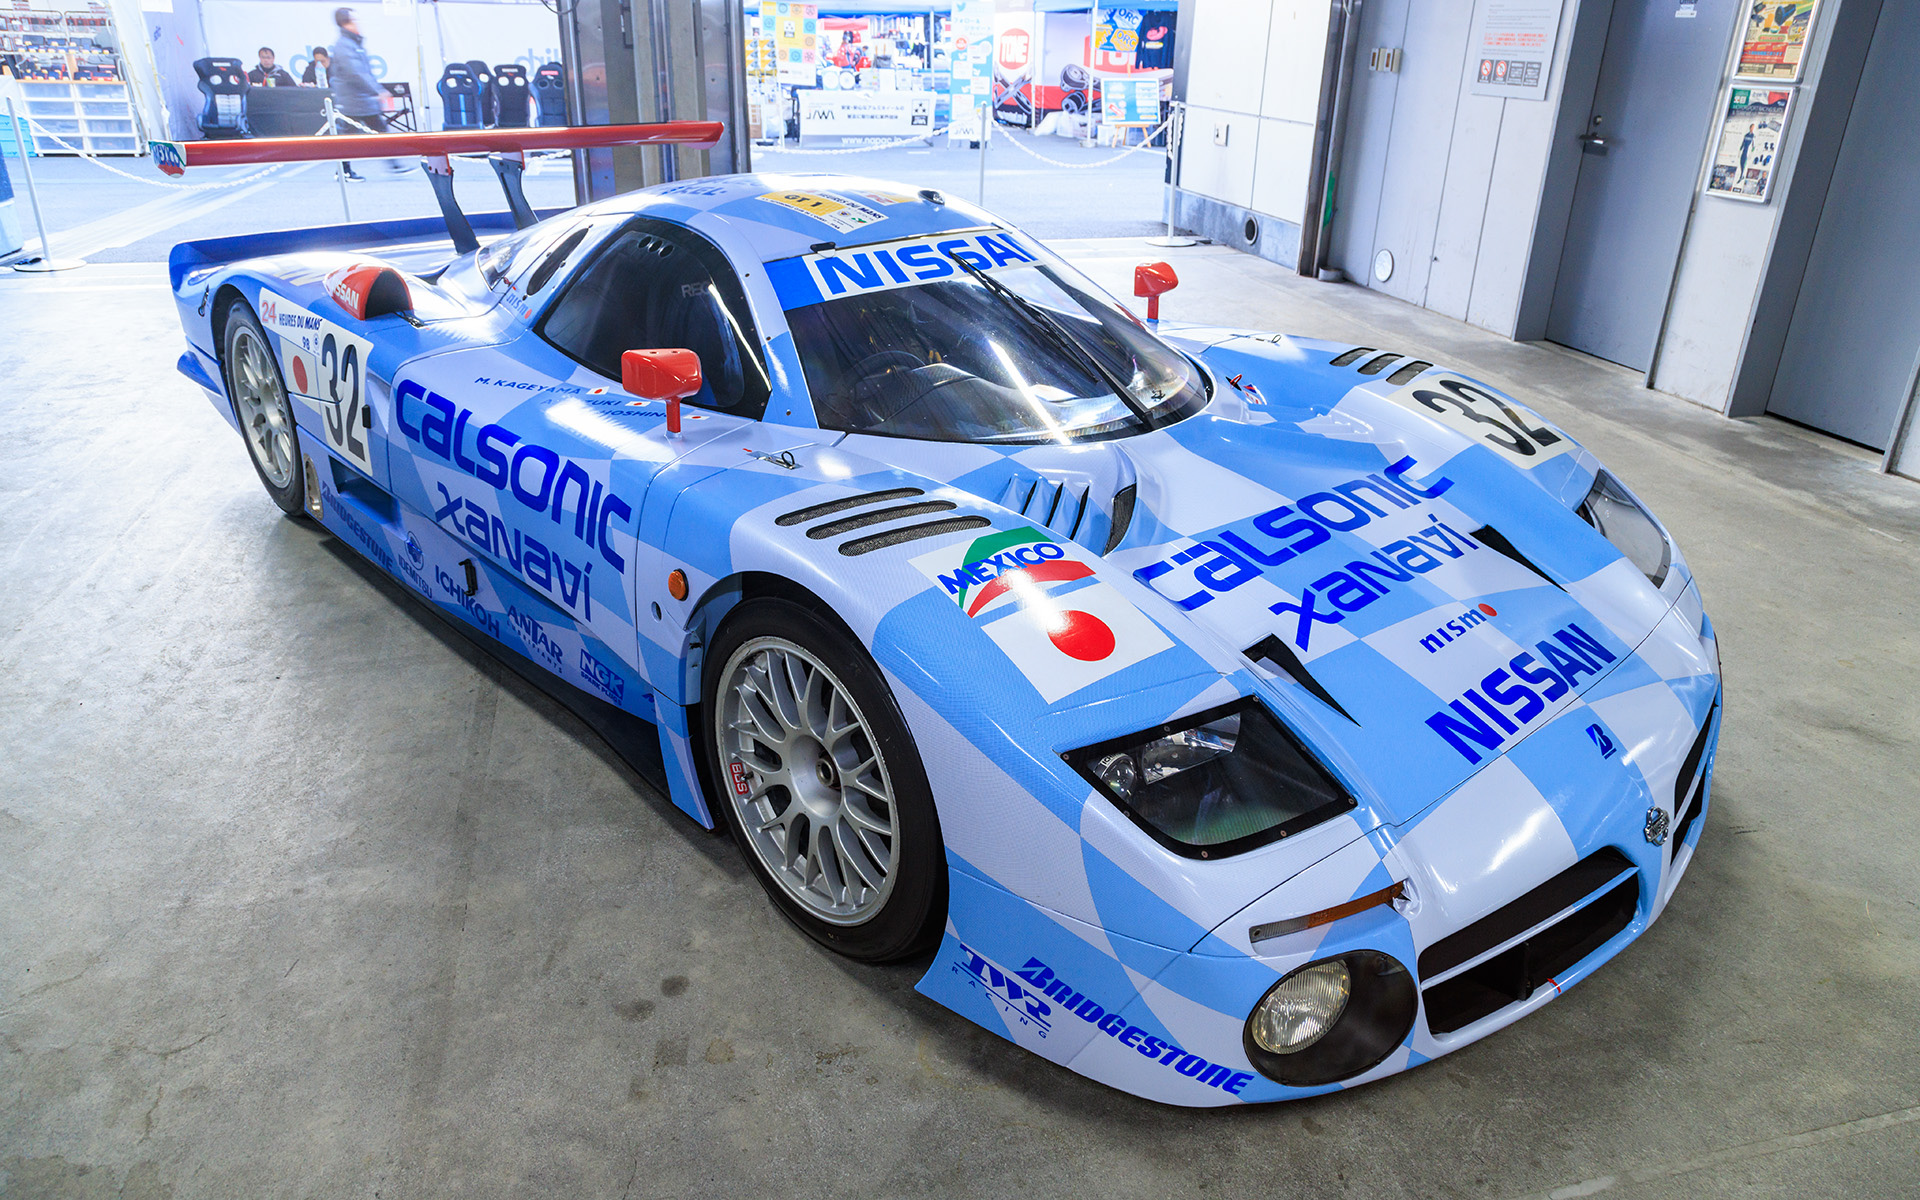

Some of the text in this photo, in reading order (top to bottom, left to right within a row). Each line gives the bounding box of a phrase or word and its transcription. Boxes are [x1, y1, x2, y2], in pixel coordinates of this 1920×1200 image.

[1116, 30, 1137, 48] ORC
[1118, 8, 1139, 25] ORC
[784, 194, 811, 203] GT
[261, 300, 277, 324] 24
[278, 313, 323, 331] HEURES DU MANS
[302, 336, 311, 350] 98
[322, 333, 366, 462] 32
[474, 377, 581, 395] M. KAGEYAMA
[1412, 379, 1562, 456] 32
[322, 481, 393, 573] BRIDGESTONE
[398, 553, 433, 599] IDEMITSU
[936, 543, 1065, 595] MEXICO
[435, 564, 500, 639] ICHIKOH
[507, 604, 563, 665] ANTAR
[580, 670, 601, 690] SPARK
[601, 686, 622, 706] PLUGS
[581, 649, 624, 700] NGK
[1424, 622, 1617, 765] NISSAN
[951, 965, 1047, 1039] RACING
[1014, 957, 1254, 1095] BRIDGESTONE
